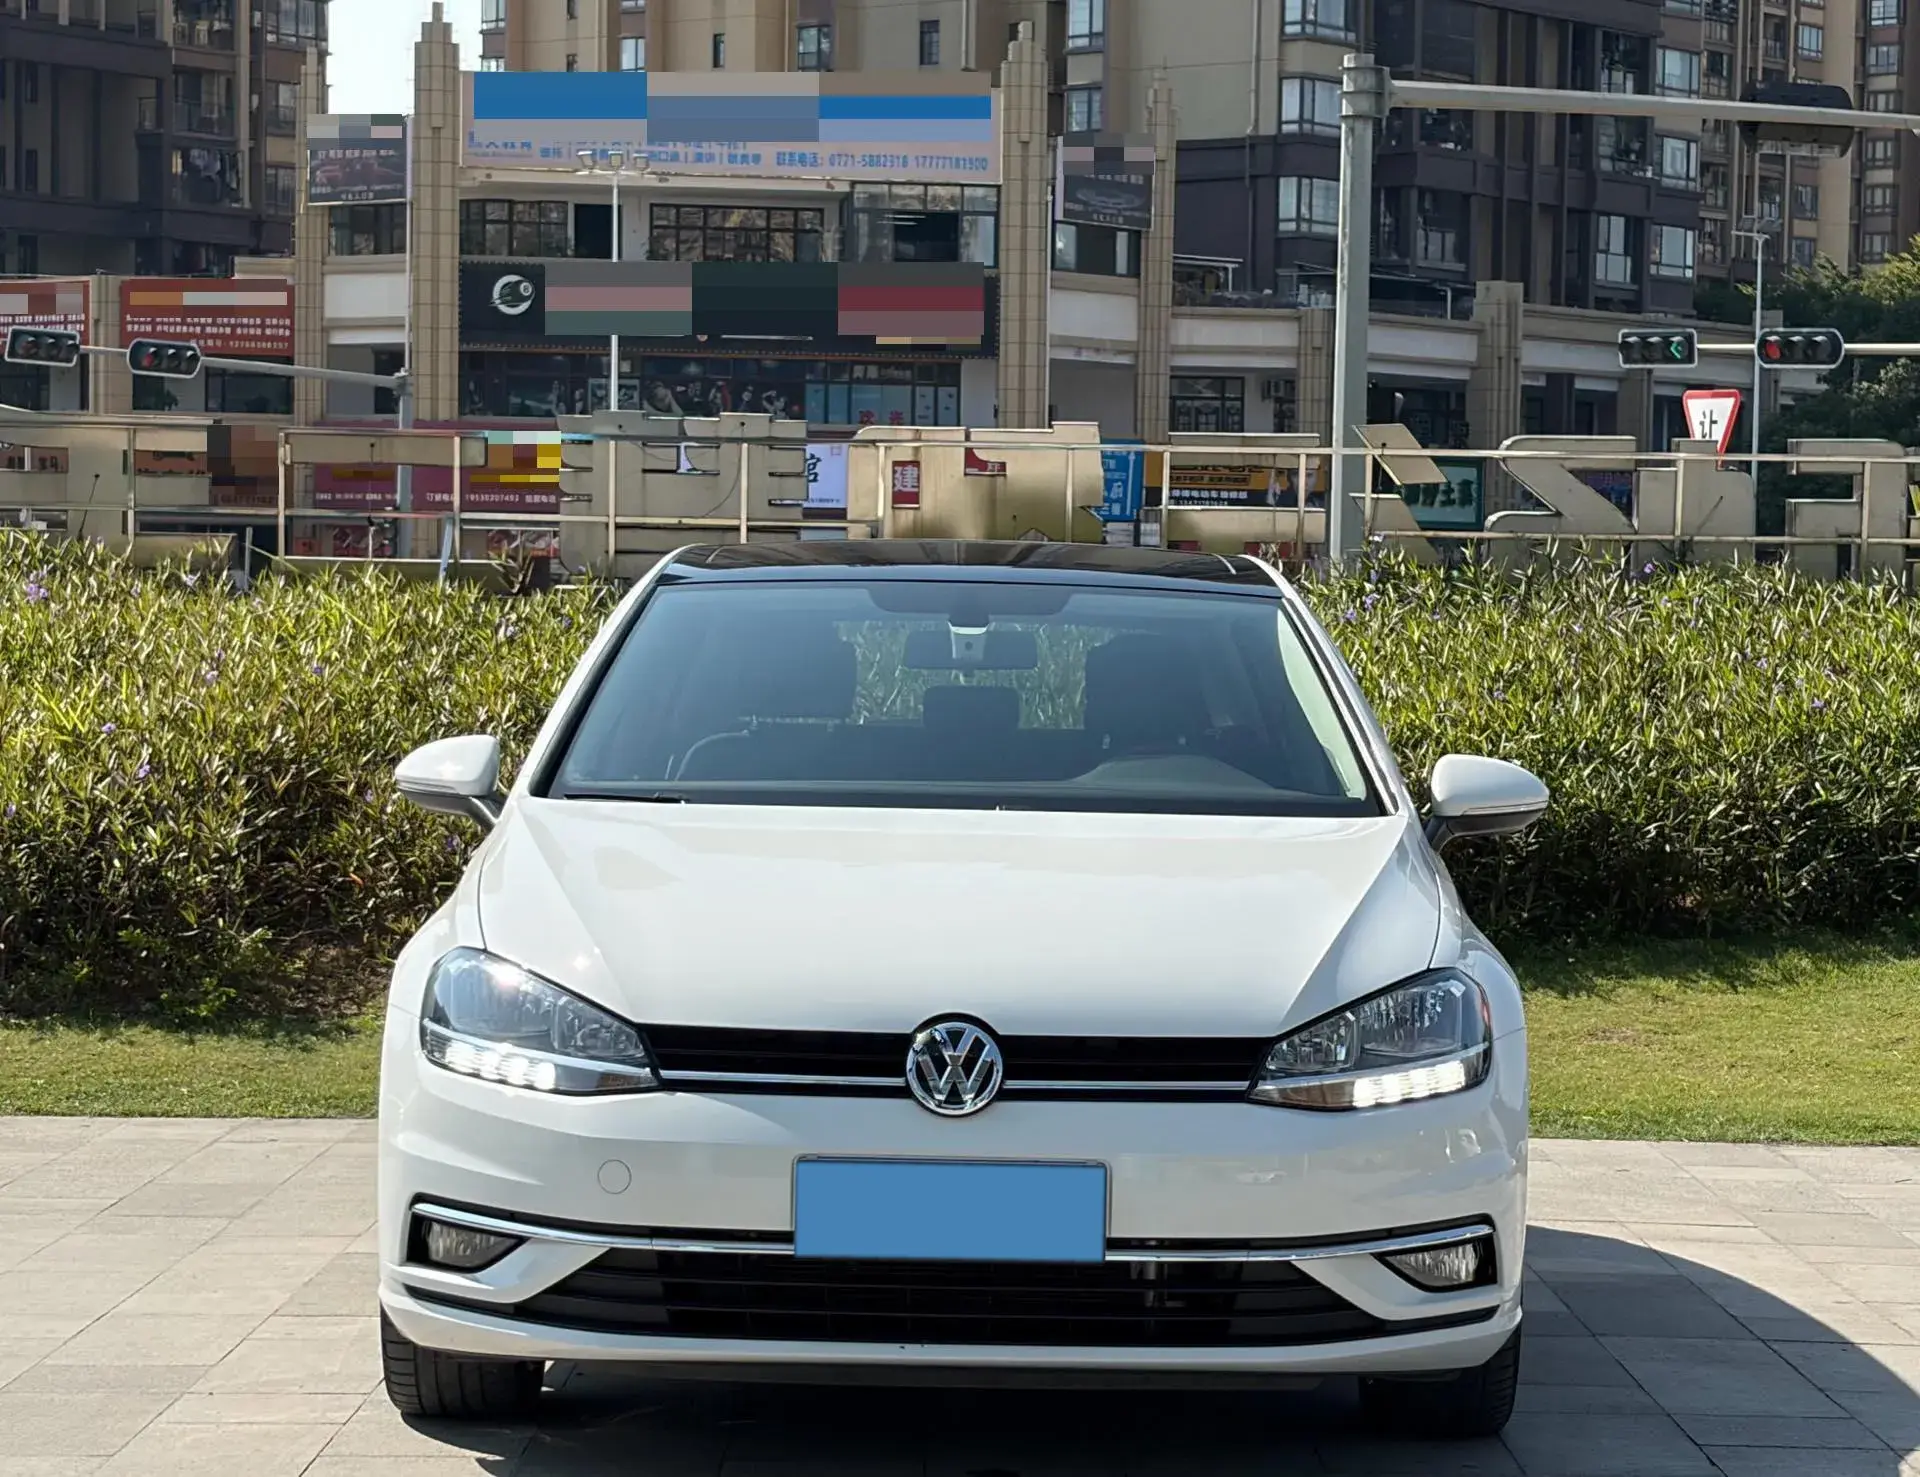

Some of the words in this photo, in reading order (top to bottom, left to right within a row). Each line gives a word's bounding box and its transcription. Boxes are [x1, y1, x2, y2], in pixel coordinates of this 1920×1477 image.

[1699, 409, 1718, 440] 让
[894, 465, 919, 492] 建
[911, 1024, 999, 1110] VW
